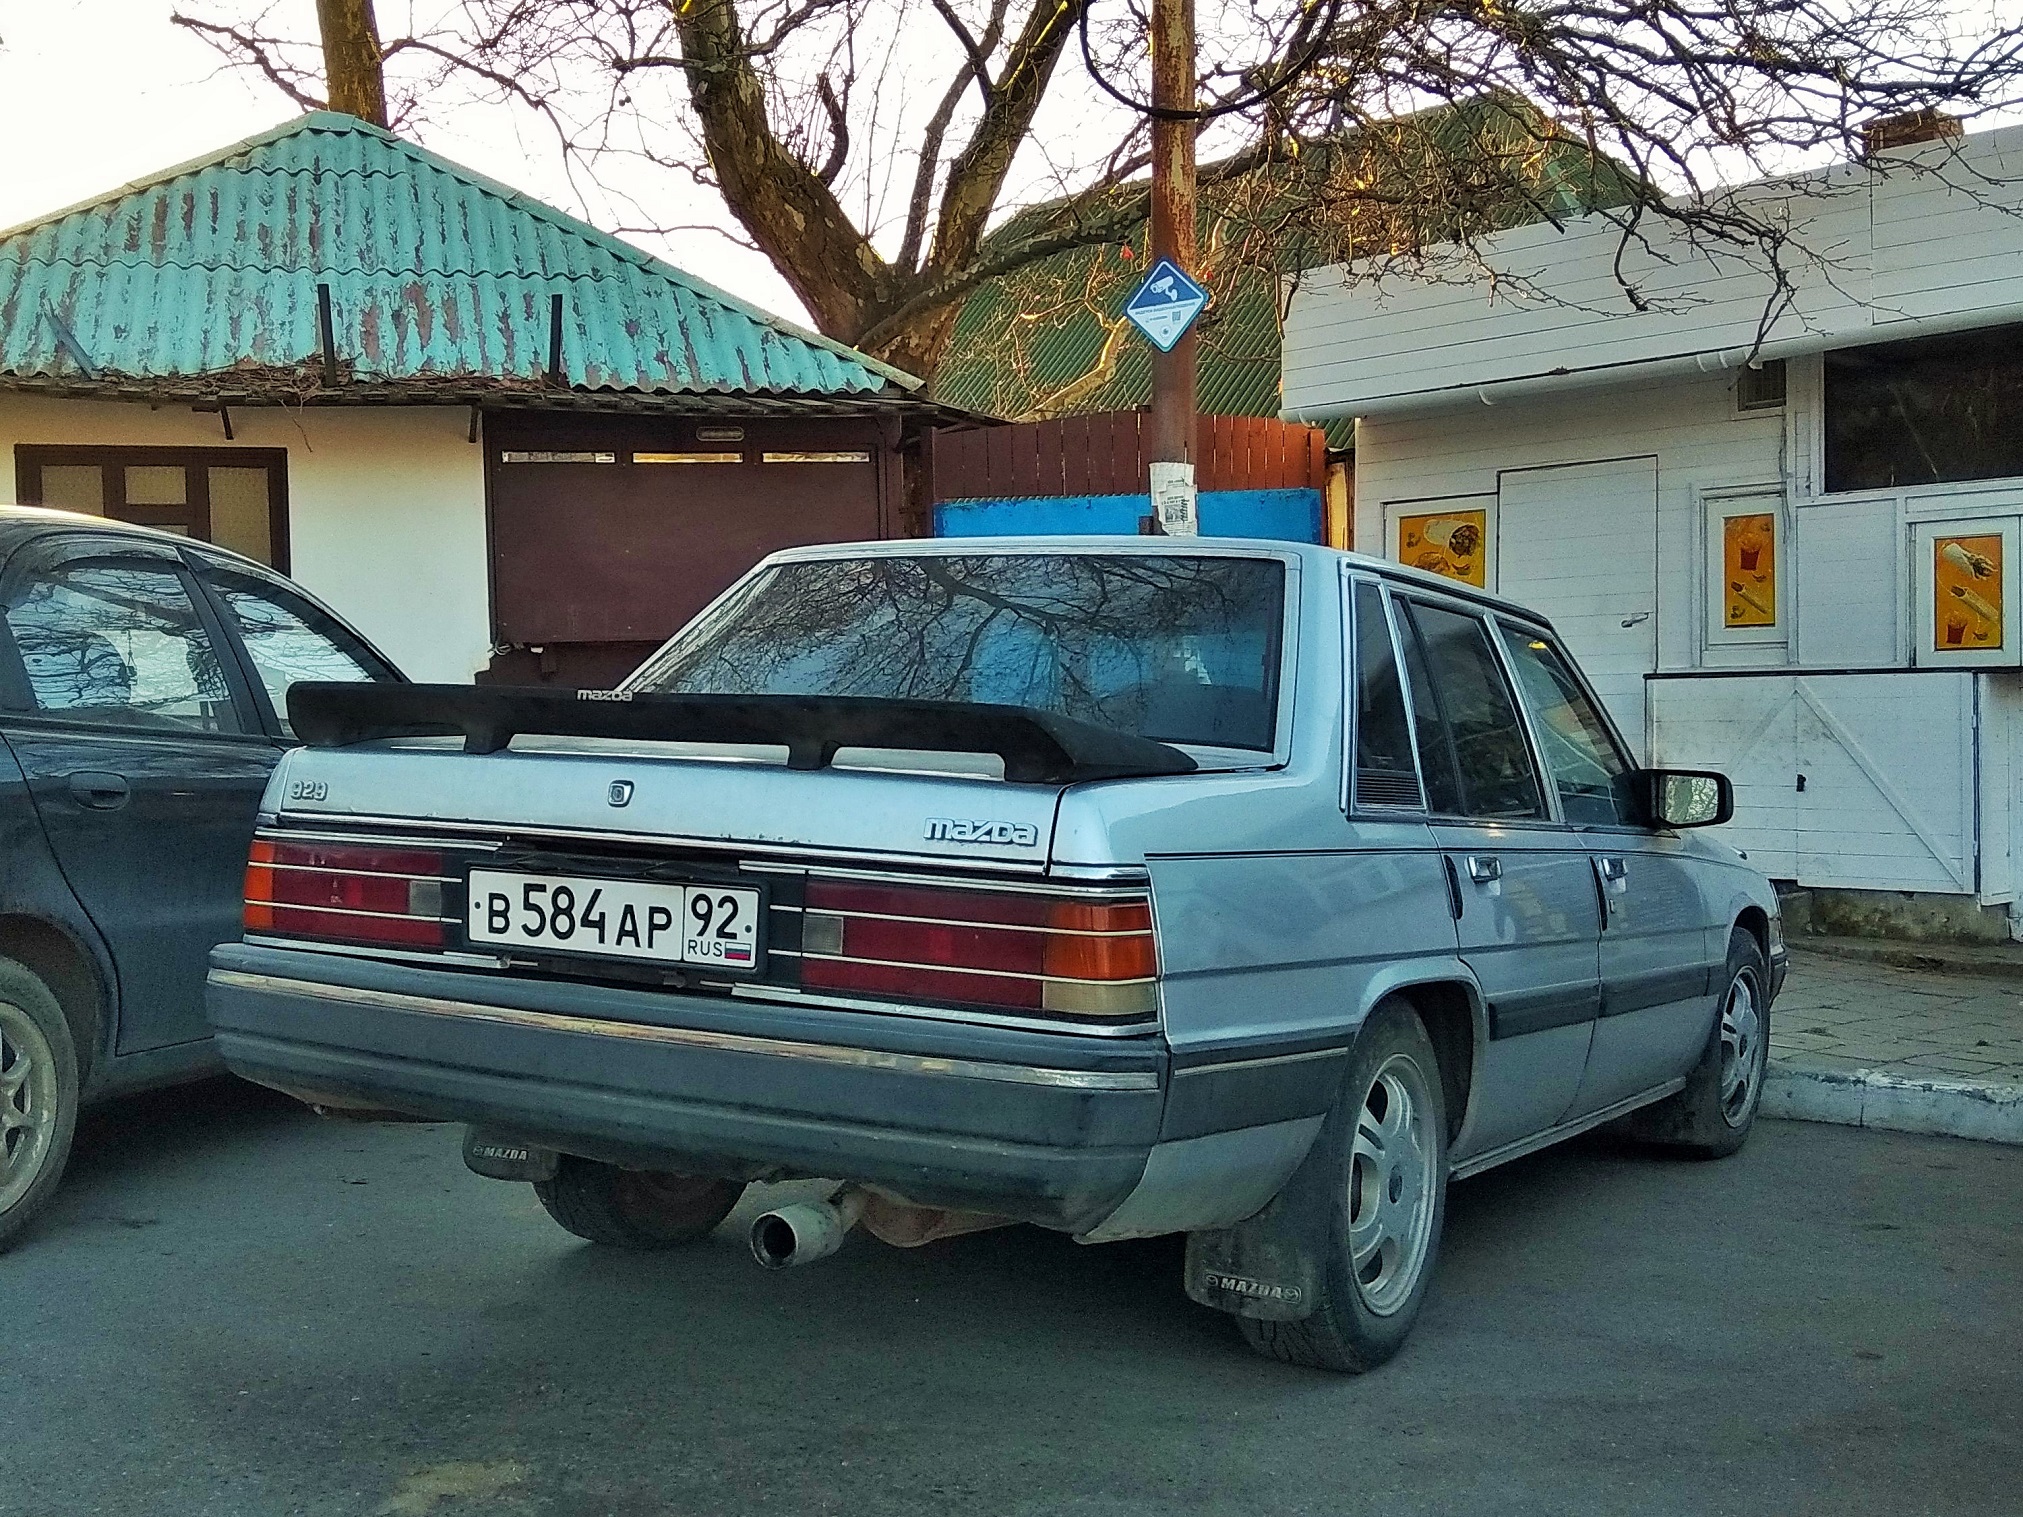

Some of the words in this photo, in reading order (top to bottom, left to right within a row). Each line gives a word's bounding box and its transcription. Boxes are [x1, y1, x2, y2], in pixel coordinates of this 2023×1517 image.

[290, 780, 329, 802] 929
[690, 893, 739, 940] 92
[687, 939, 723, 958] RUS
[483, 1146, 528, 1161] MAZDA
[1220, 1277, 1282, 1299] MAZDA
